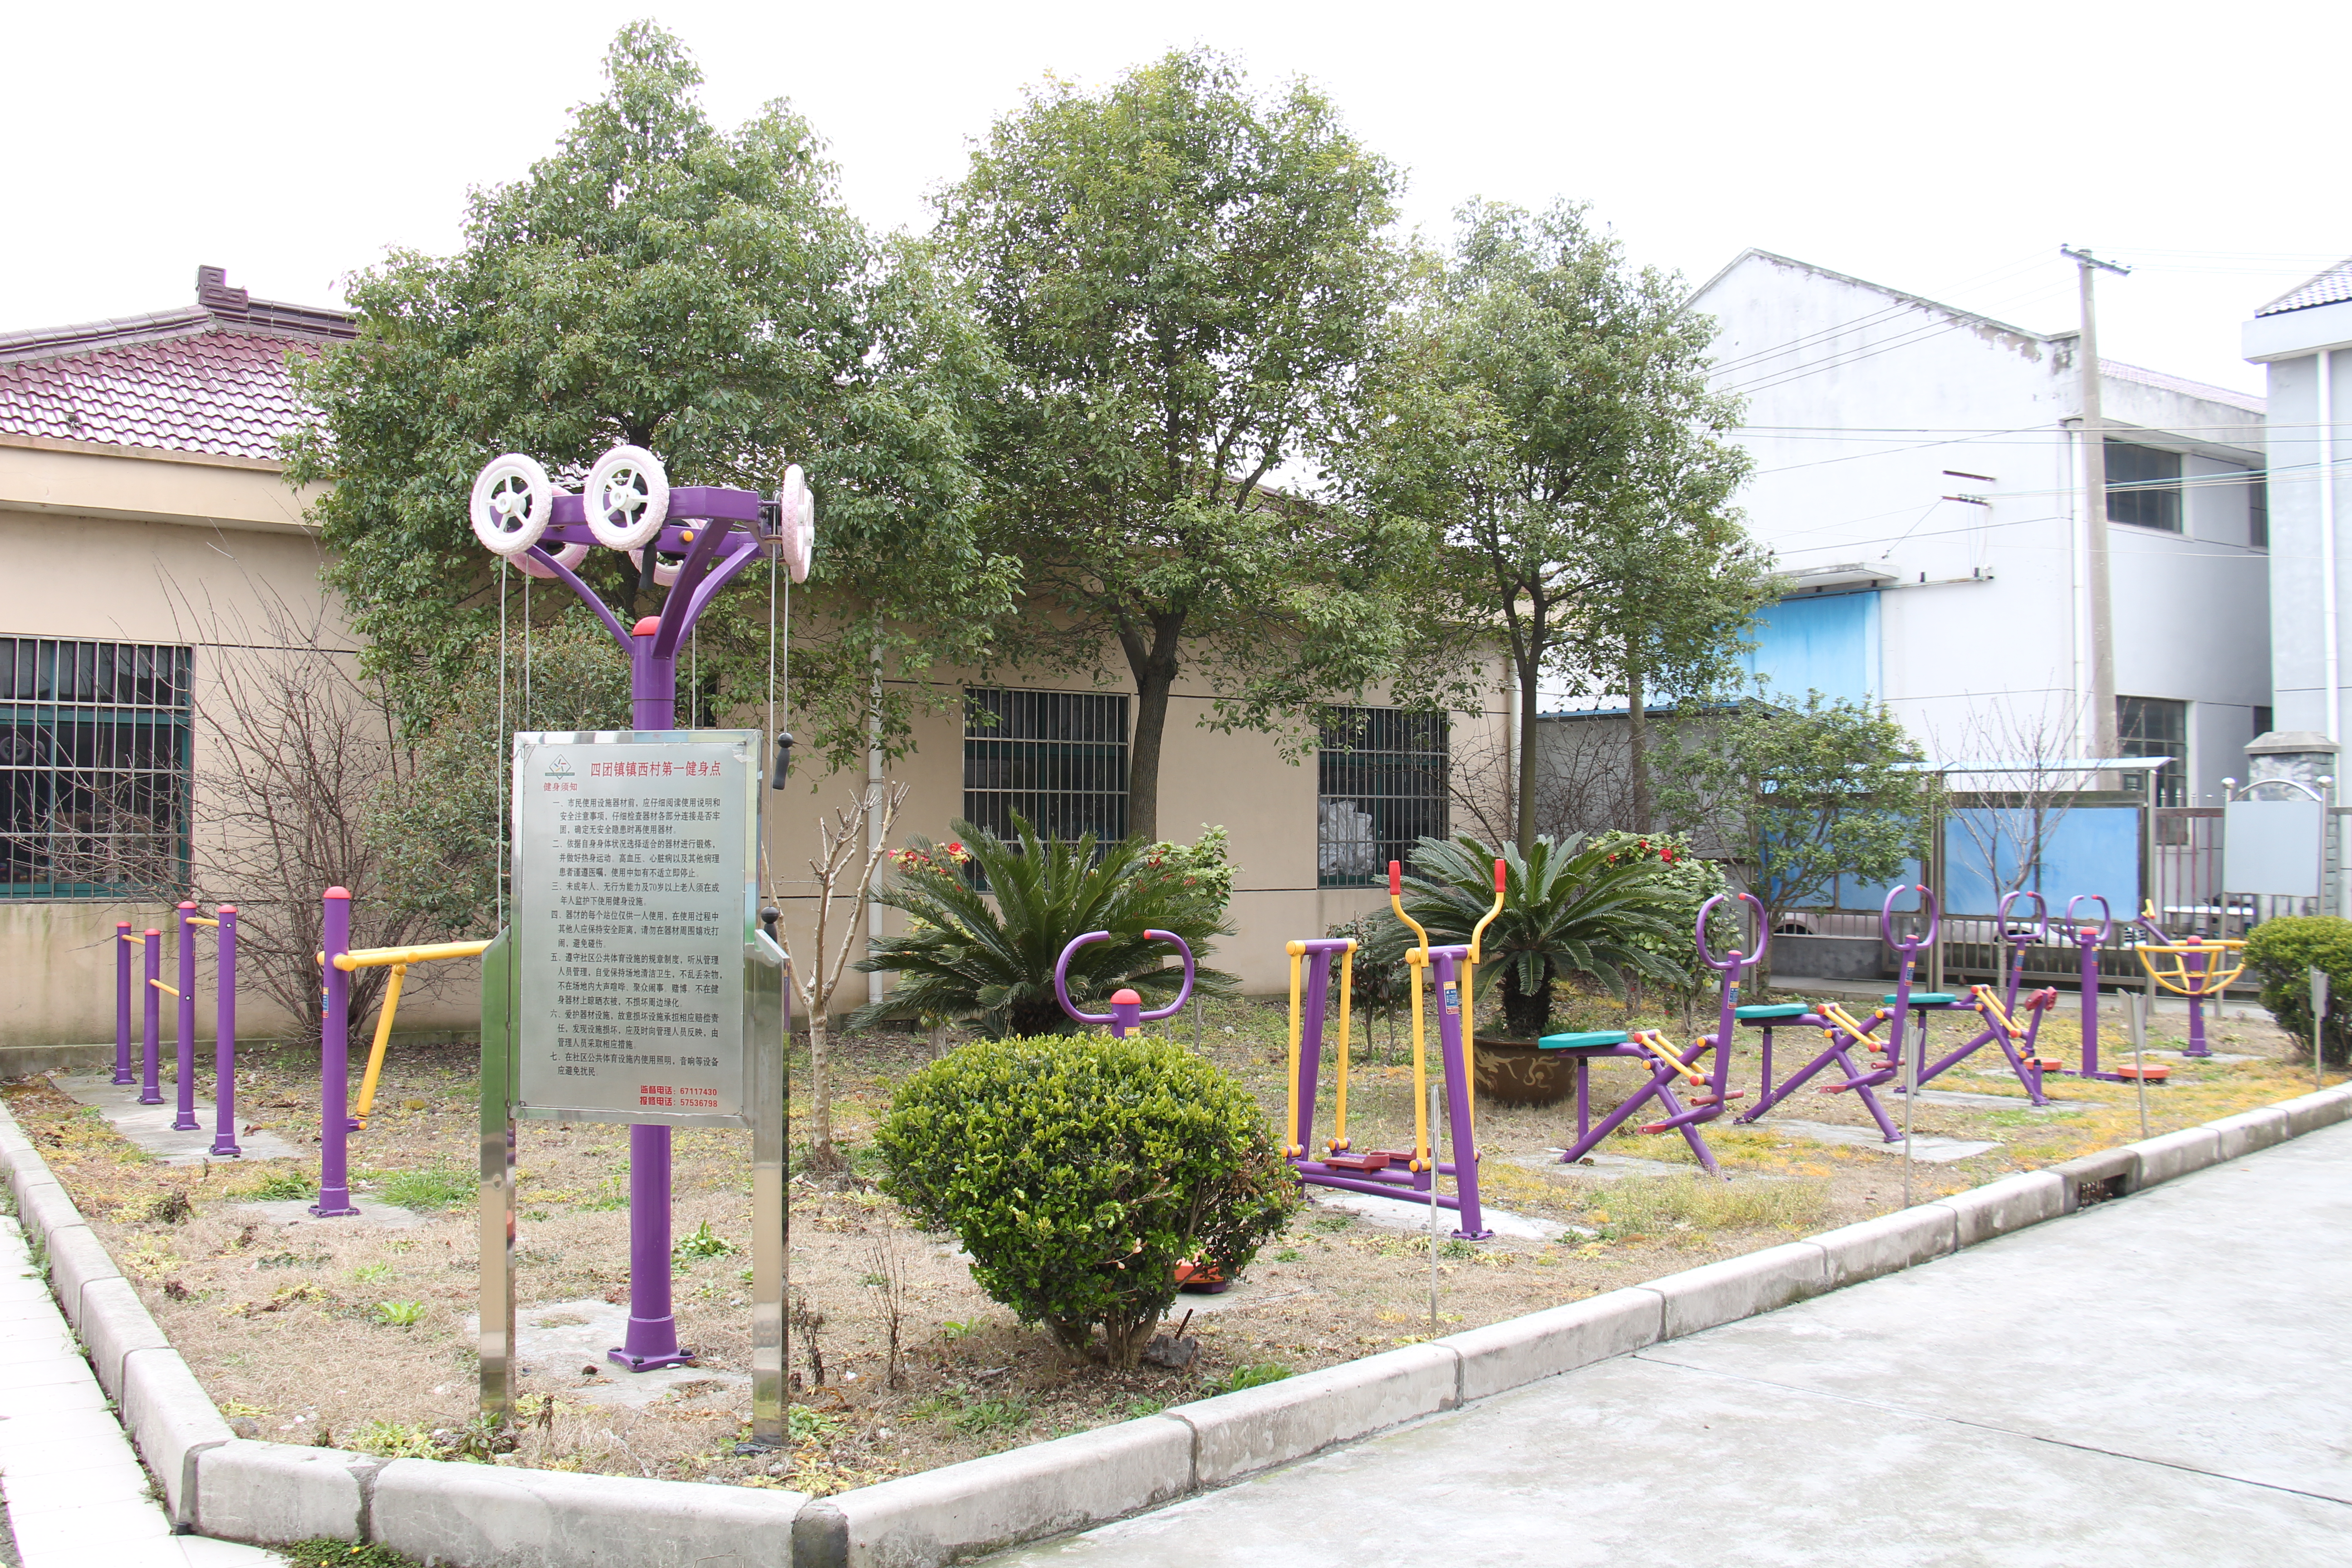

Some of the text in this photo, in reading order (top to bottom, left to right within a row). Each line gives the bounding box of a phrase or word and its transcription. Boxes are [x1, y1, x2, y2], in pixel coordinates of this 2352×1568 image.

[591, 760, 720, 777] 四团镇镇西村第一健身点
[544, 782, 578, 792] 健身须知
[553, 798, 720, 808] 一、市民使用设施器材前，应仔细阅读使用说明和
[559, 811, 720, 821] 安全注意事项，仔细检查器材各部分连接是否牢
[559, 825, 676, 835] 固，确定无安全隐患时再使用器材。
[552, 838, 715, 849] 二、依据自身身体状况选择适合的器材进行锻炼，
[559, 853, 720, 863] 并做好热身运动。高血压、心脏病以及其他病理
[552, 882, 720, 892] 三、未成年人、无行为能力及70岁以上老人须在成
[560, 896, 647, 906] 年人监护下使用健身设施。
[551, 910, 719, 922] 四、器材的每个站位仅供一人使用，在使用过程中
[558, 924, 719, 936] 其他人应保持安全距离，请勿在器材周围嬉戏打
[558, 938, 607, 949] 闹，避免碰伤。
[551, 953, 719, 965] 五、遵守社区公共体育设施的规章制度，听从管理
[558, 967, 722, 979] 人员管理，自觉保持场地清洁卫生，不乱丢杂物，
[557, 981, 719, 994] 不在场地内大声喧哗、聚众闹事。赌博。不在健
[558, 995, 682, 1008] 身器材上晾晒衣被，不损坏周边绿化。
[550, 1009, 719, 1023] 六、爱护器材设施，故意损坏设施承担相应赔偿责
[558, 1024, 718, 1038] 任，发现设施损坏，应及时向管理人员反映，由
[558, 1038, 637, 1049] 管理人员采取相应措施。
[550, 1052, 719, 1067] 七、在社区公共体育设施内使用照明，音响等设备
[558, 1066, 599, 1076] 应避免扰民。
